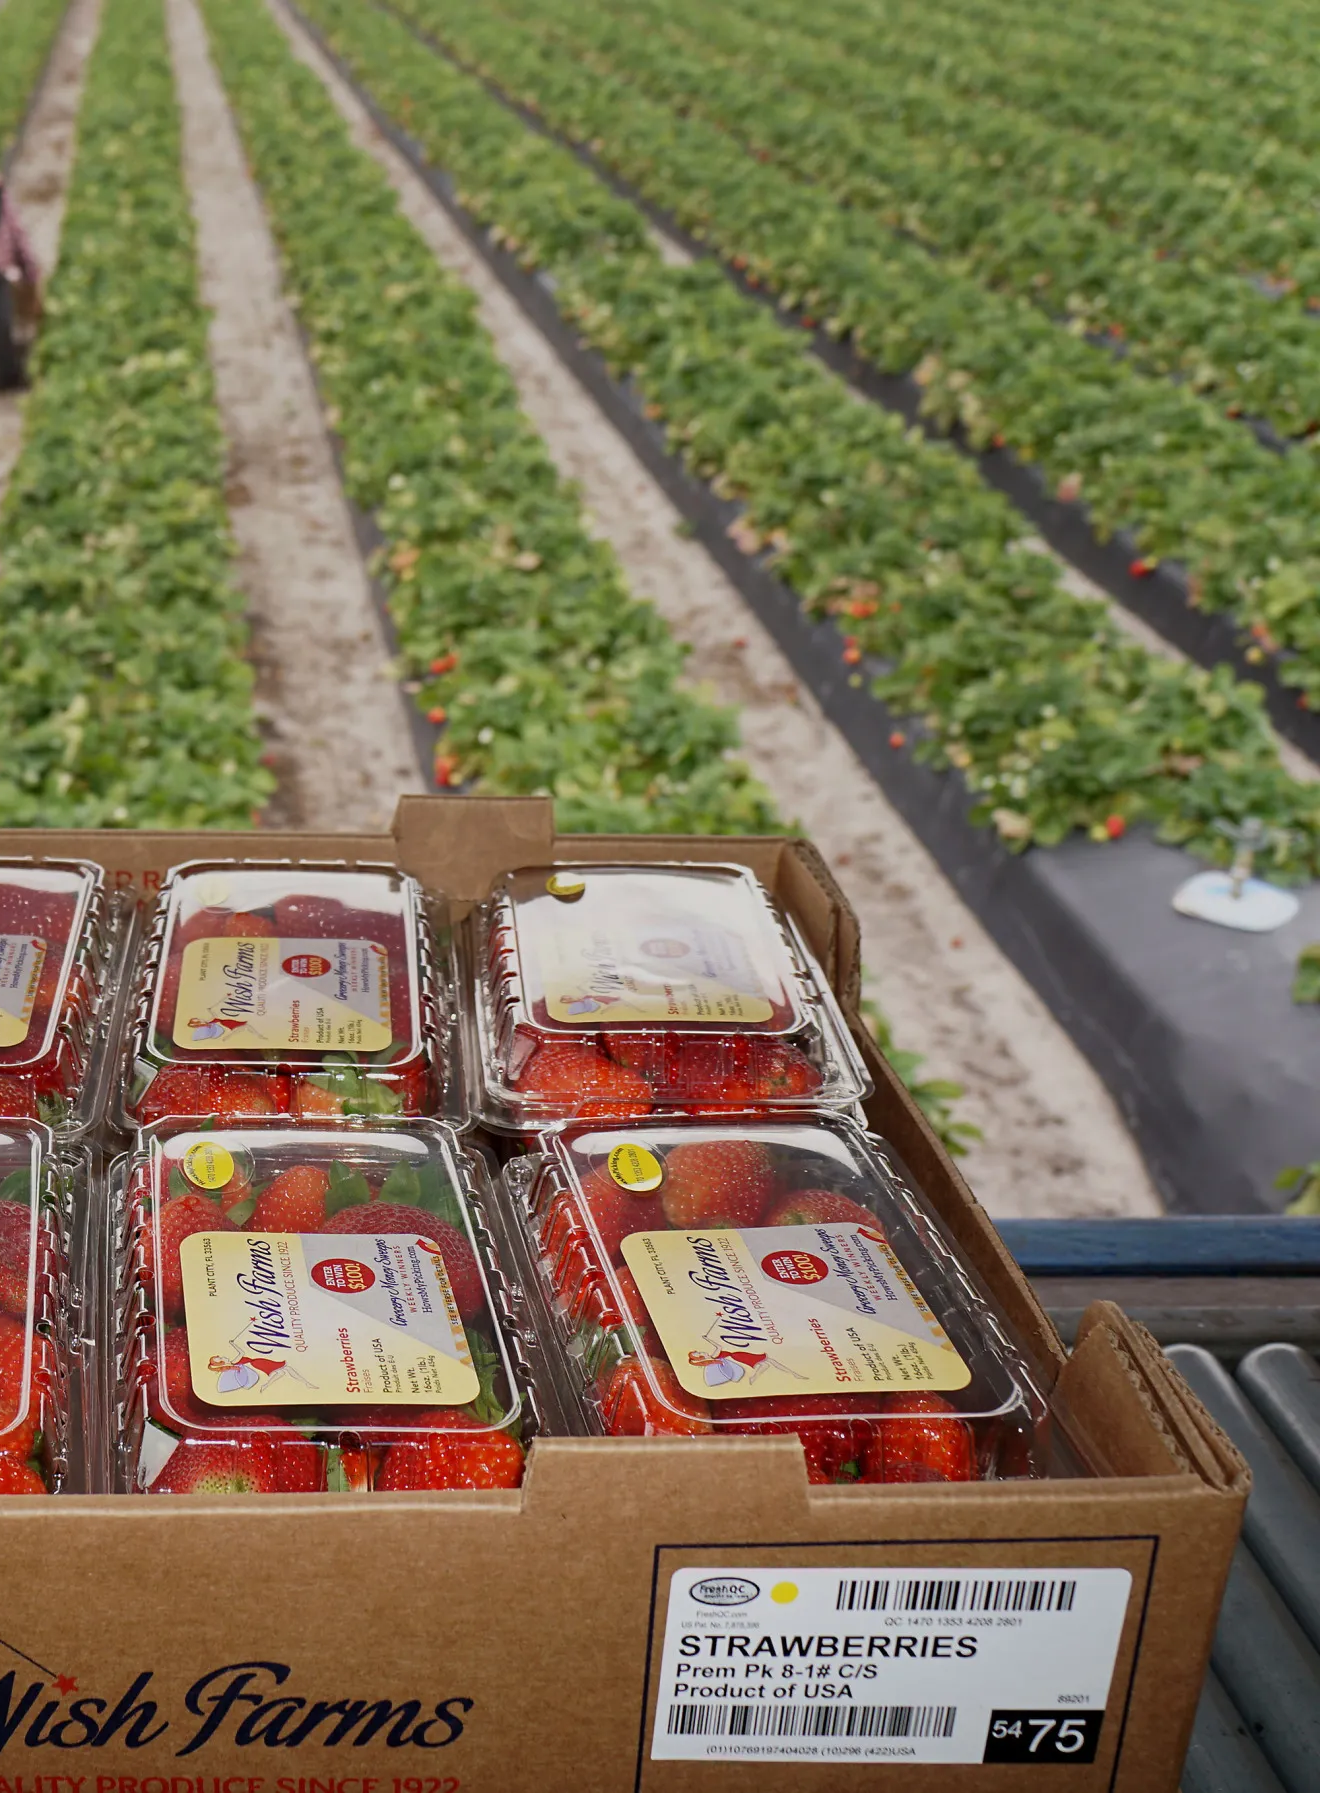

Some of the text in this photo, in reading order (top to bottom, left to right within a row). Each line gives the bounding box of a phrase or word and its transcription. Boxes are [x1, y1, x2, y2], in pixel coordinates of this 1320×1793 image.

[220, 941, 255, 1016] Wish Farms
[288, 1000, 299, 1041] Strawberries
[202, 1238, 212, 1253] 33563
[205, 1263, 214, 1276] CITY,
[323, 1266, 335, 1285] ENTER
[332, 1264, 345, 1287] TO WIN
[344, 1263, 366, 1289] $100!
[407, 1245, 432, 1312] HowsMyPicking.com
[654, 1262, 666, 1275] CITY,
[771, 1258, 789, 1278] ENTER
[780, 1256, 800, 1279] TO WIN
[791, 1254, 821, 1279] $100!
[814, 1228, 876, 1314] Grocery Money Sweeps
[850, 1234, 897, 1300] HowsMyPicking.com
[207, 1277, 216, 1296] PLANT
[236, 1238, 290, 1353] Wish Farms
[373, 1238, 407, 1326] Grocery Money Sweeps
[660, 1276, 675, 1294] PLANT
[686, 1236, 766, 1347] Wish Farms
[717, 1237, 783, 1344] QUALITY PRODUCE SINCE 1922
[276, 1241, 307, 1352] QUALITY PRODUCE SINCE 1922
[845, 1327, 860, 1341] USA
[338, 1328, 360, 1392] Strawberries
[808, 1318, 851, 1381] Strawberries
[371, 1338, 392, 1392] Product of USA
[861, 1352, 884, 1380] Product
[678, 1635, 978, 1658] STRAWBERRIES
[676, 1663, 879, 1680] Prem Pk 8-1# C/S
[674, 1683, 854, 1700] Product of USA
[175, 1661, 475, 1758] Farms
[991, 1719, 1087, 1753] 54 75
[96, 1776, 266, 1793] PRODUCE
[276, 1777, 380, 1793] SINCE
[392, 1777, 461, 1793] 1922
